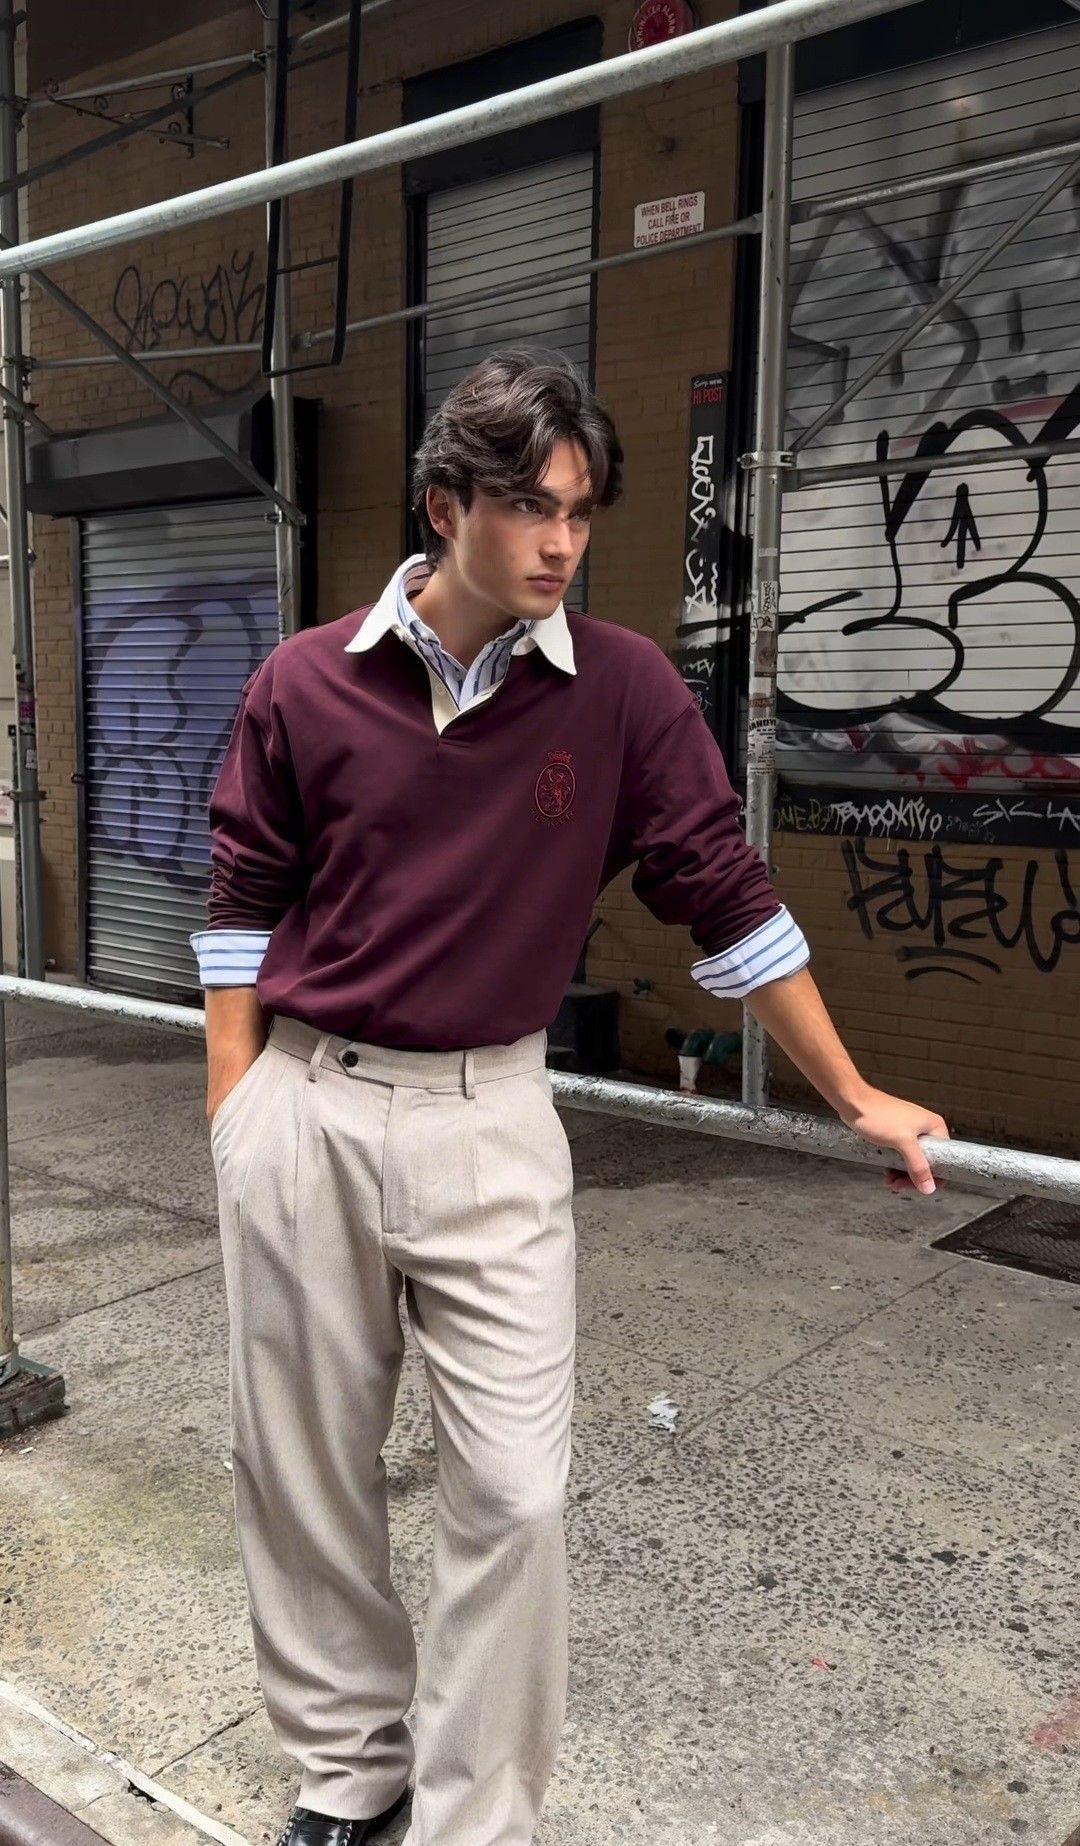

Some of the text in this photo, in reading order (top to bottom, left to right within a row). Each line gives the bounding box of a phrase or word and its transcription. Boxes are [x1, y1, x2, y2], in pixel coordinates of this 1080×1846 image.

[641, 195, 698, 218] WHEN BELL RINGS
[647, 211, 691, 230] CALL FIRE OR
[636, 222, 702, 246] POLICE DEPARTMENT
